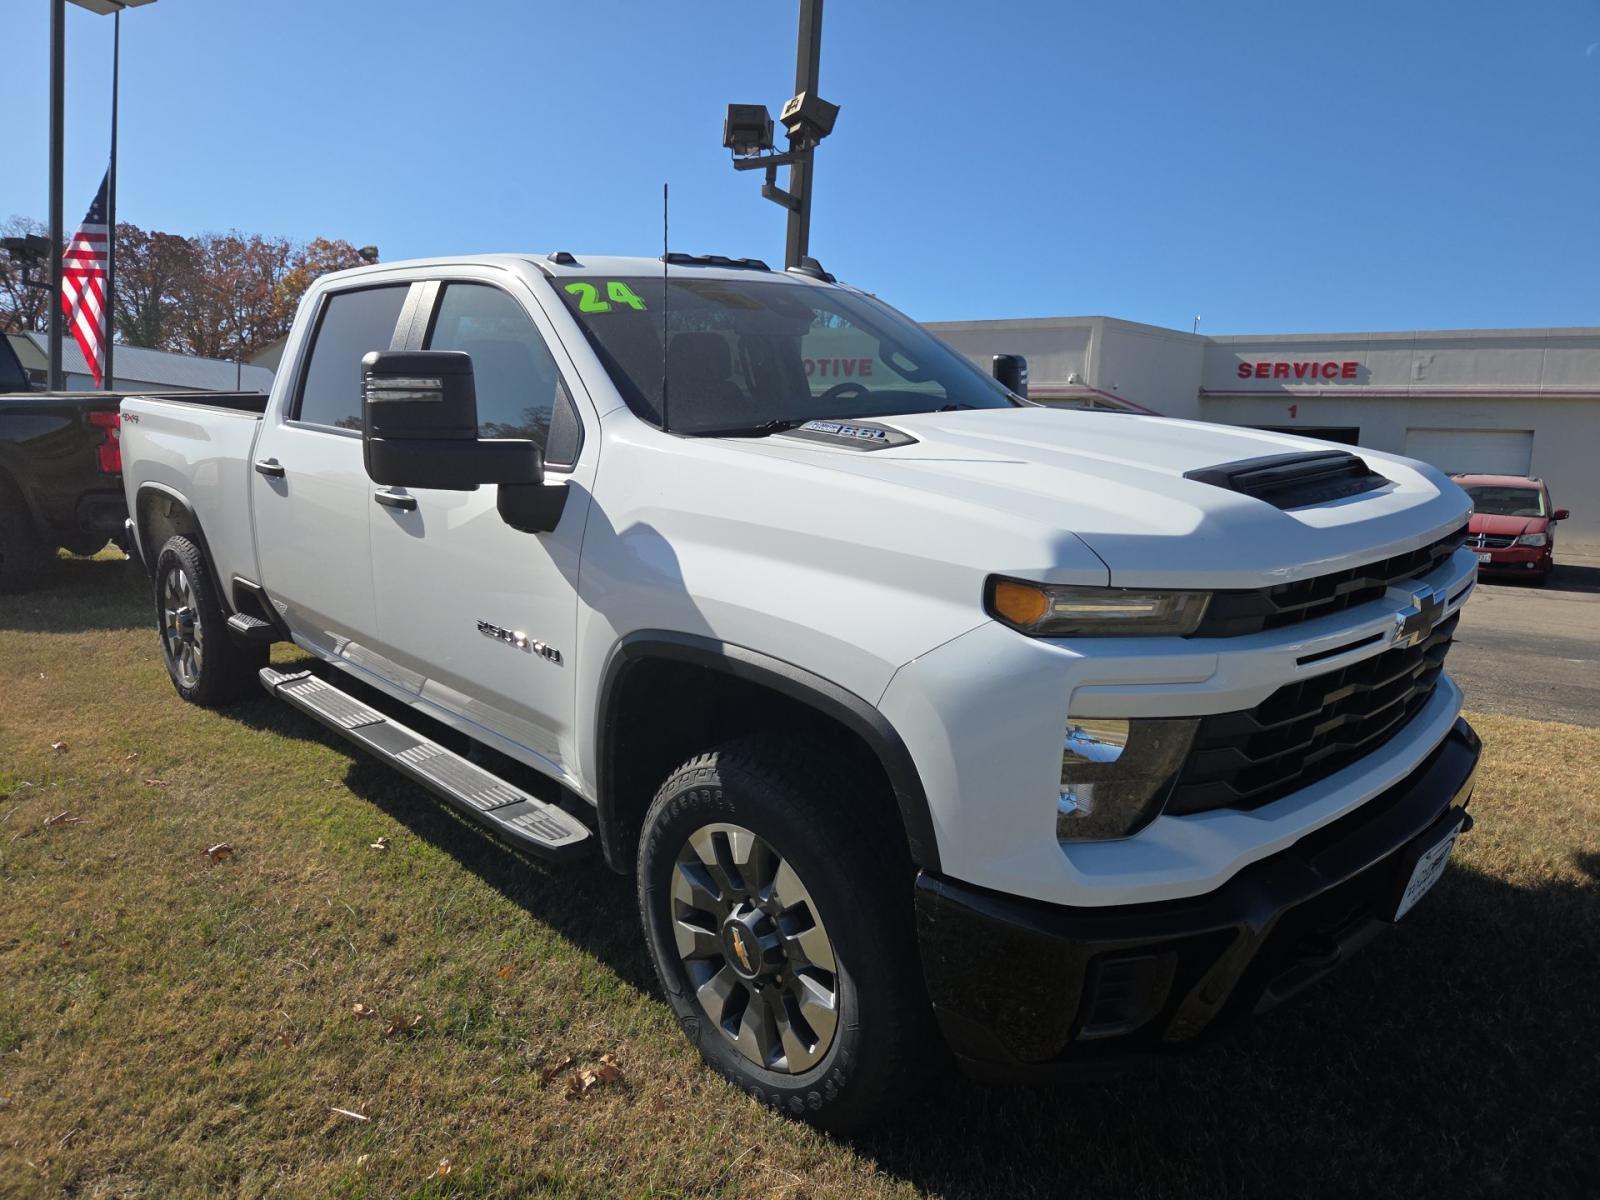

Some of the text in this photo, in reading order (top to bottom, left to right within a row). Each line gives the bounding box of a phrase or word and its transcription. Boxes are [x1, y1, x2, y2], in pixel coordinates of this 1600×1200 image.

[564, 282, 647, 313] 24
[1237, 361, 1359, 379] SERVICE
[1288, 404, 1298, 419] 1
